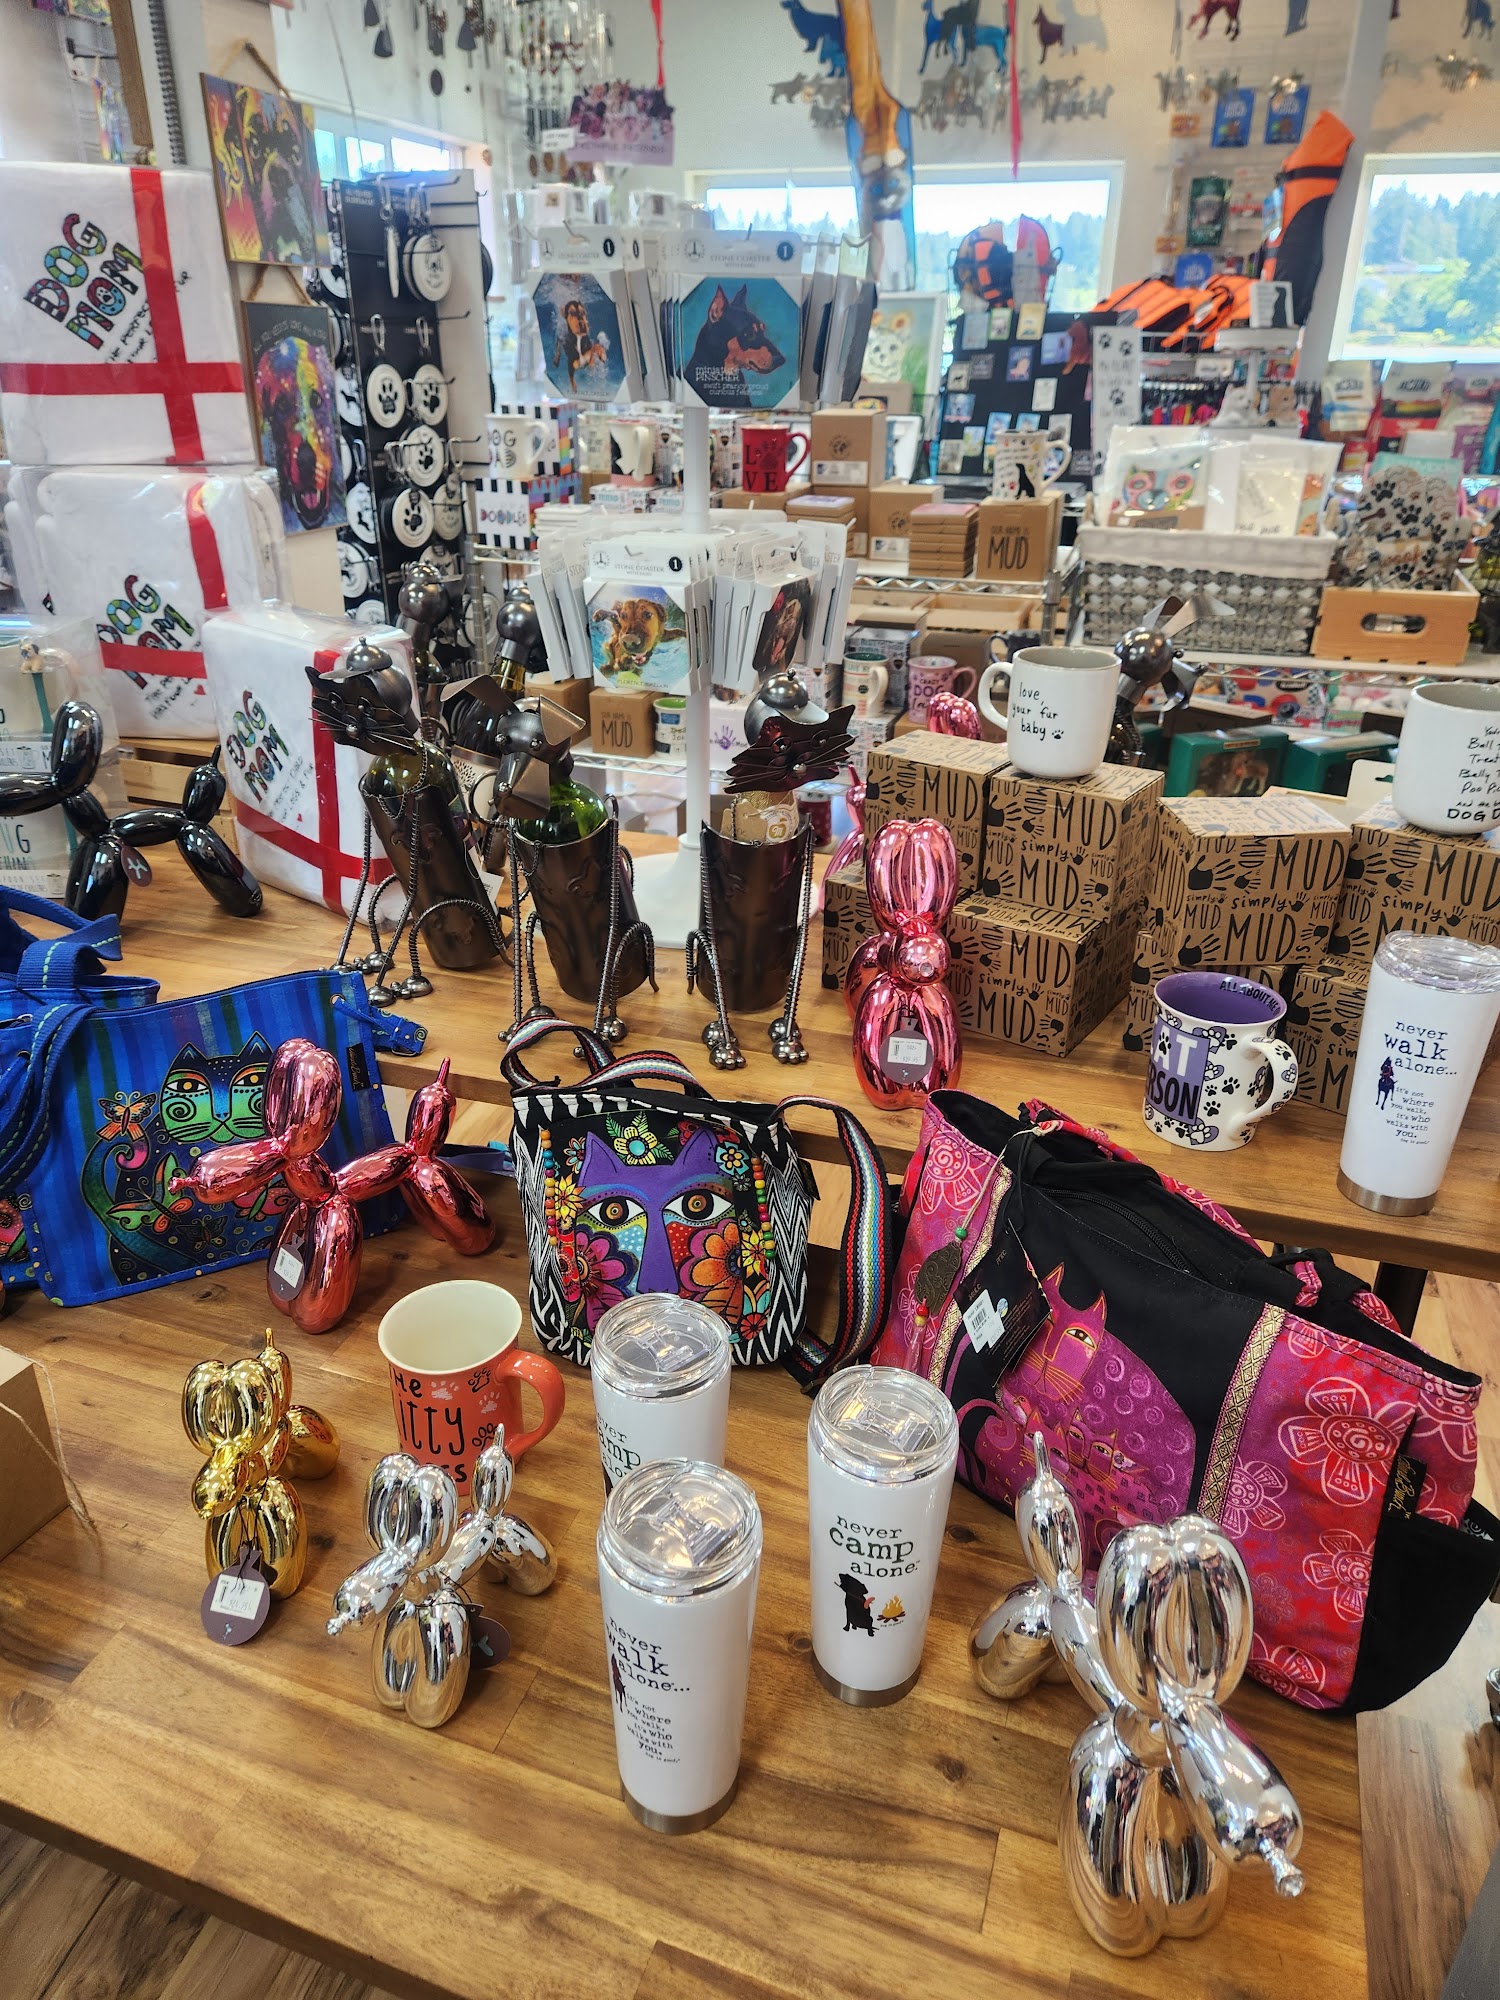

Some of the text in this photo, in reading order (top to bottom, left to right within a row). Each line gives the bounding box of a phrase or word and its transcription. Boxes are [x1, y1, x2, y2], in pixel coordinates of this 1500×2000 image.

[23, 213, 108, 323] DOG
[65, 242, 145, 350] MOM
[695, 374, 740, 382] PINSCHER
[490, 429, 517, 447] OG
[988, 536, 1029, 570] MUD
[636, 564, 665, 572] COASTER
[1012, 704, 1059, 719] your fur
[226, 689, 267, 770] DOG
[602, 720, 634, 748] MUD
[1021, 718, 1046, 741] baby
[244, 723, 290, 804] MOM
[1458, 768, 1492, 783] Belly
[923, 767, 978, 822] MUD
[1461, 781, 1483, 794] Poo
[1053, 792, 1117, 851] MUD
[1447, 808, 1486, 823] DOG
[956, 831, 977, 849] MUD
[1021, 840, 1069, 862] simply
[986, 839, 1014, 866] MUD
[1090, 860, 1114, 879] MUD
[1270, 839, 1346, 892] MUD
[1019, 855, 1079, 910] MUD
[1153, 840, 1186, 920] MUD
[1231, 896, 1290, 913] simply
[1310, 900, 1337, 919] MUD
[1381, 895, 1443, 922] simply
[1183, 903, 1222, 930] MUD
[1223, 913, 1296, 963] MUD
[1467, 920, 1499, 944] MUD
[823, 940, 849, 963] MUD
[1009, 930, 1071, 988] MUD
[979, 973, 1025, 996] simply
[1220, 980, 1238, 993] ALL
[1239, 985, 1270, 1004] ABOUT
[977, 986, 1035, 1043] MUD
[1046, 995, 1069, 1016] MUD
[1395, 1021, 1448, 1040] never
[1150, 1024, 1198, 1077] AT
[1384, 1033, 1448, 1060] walk
[1402, 1097, 1434, 1107] where
[1412, 1090, 1424, 1098] not
[1386, 1118, 1409, 1129] walks
[1411, 1114, 1431, 1122] who
[1396, 1129, 1418, 1138] you.
[836, 1515, 903, 1539] never
[829, 1527, 914, 1564] camp
[609, 1616, 662, 1655] never
[606, 1623, 669, 1677] walk
[635, 1706, 672, 1725] where
[642, 1704, 656, 1713] not
[627, 1725, 674, 1750] walks with
[650, 1729, 672, 1741] who
[638, 1740, 663, 1756] you.
